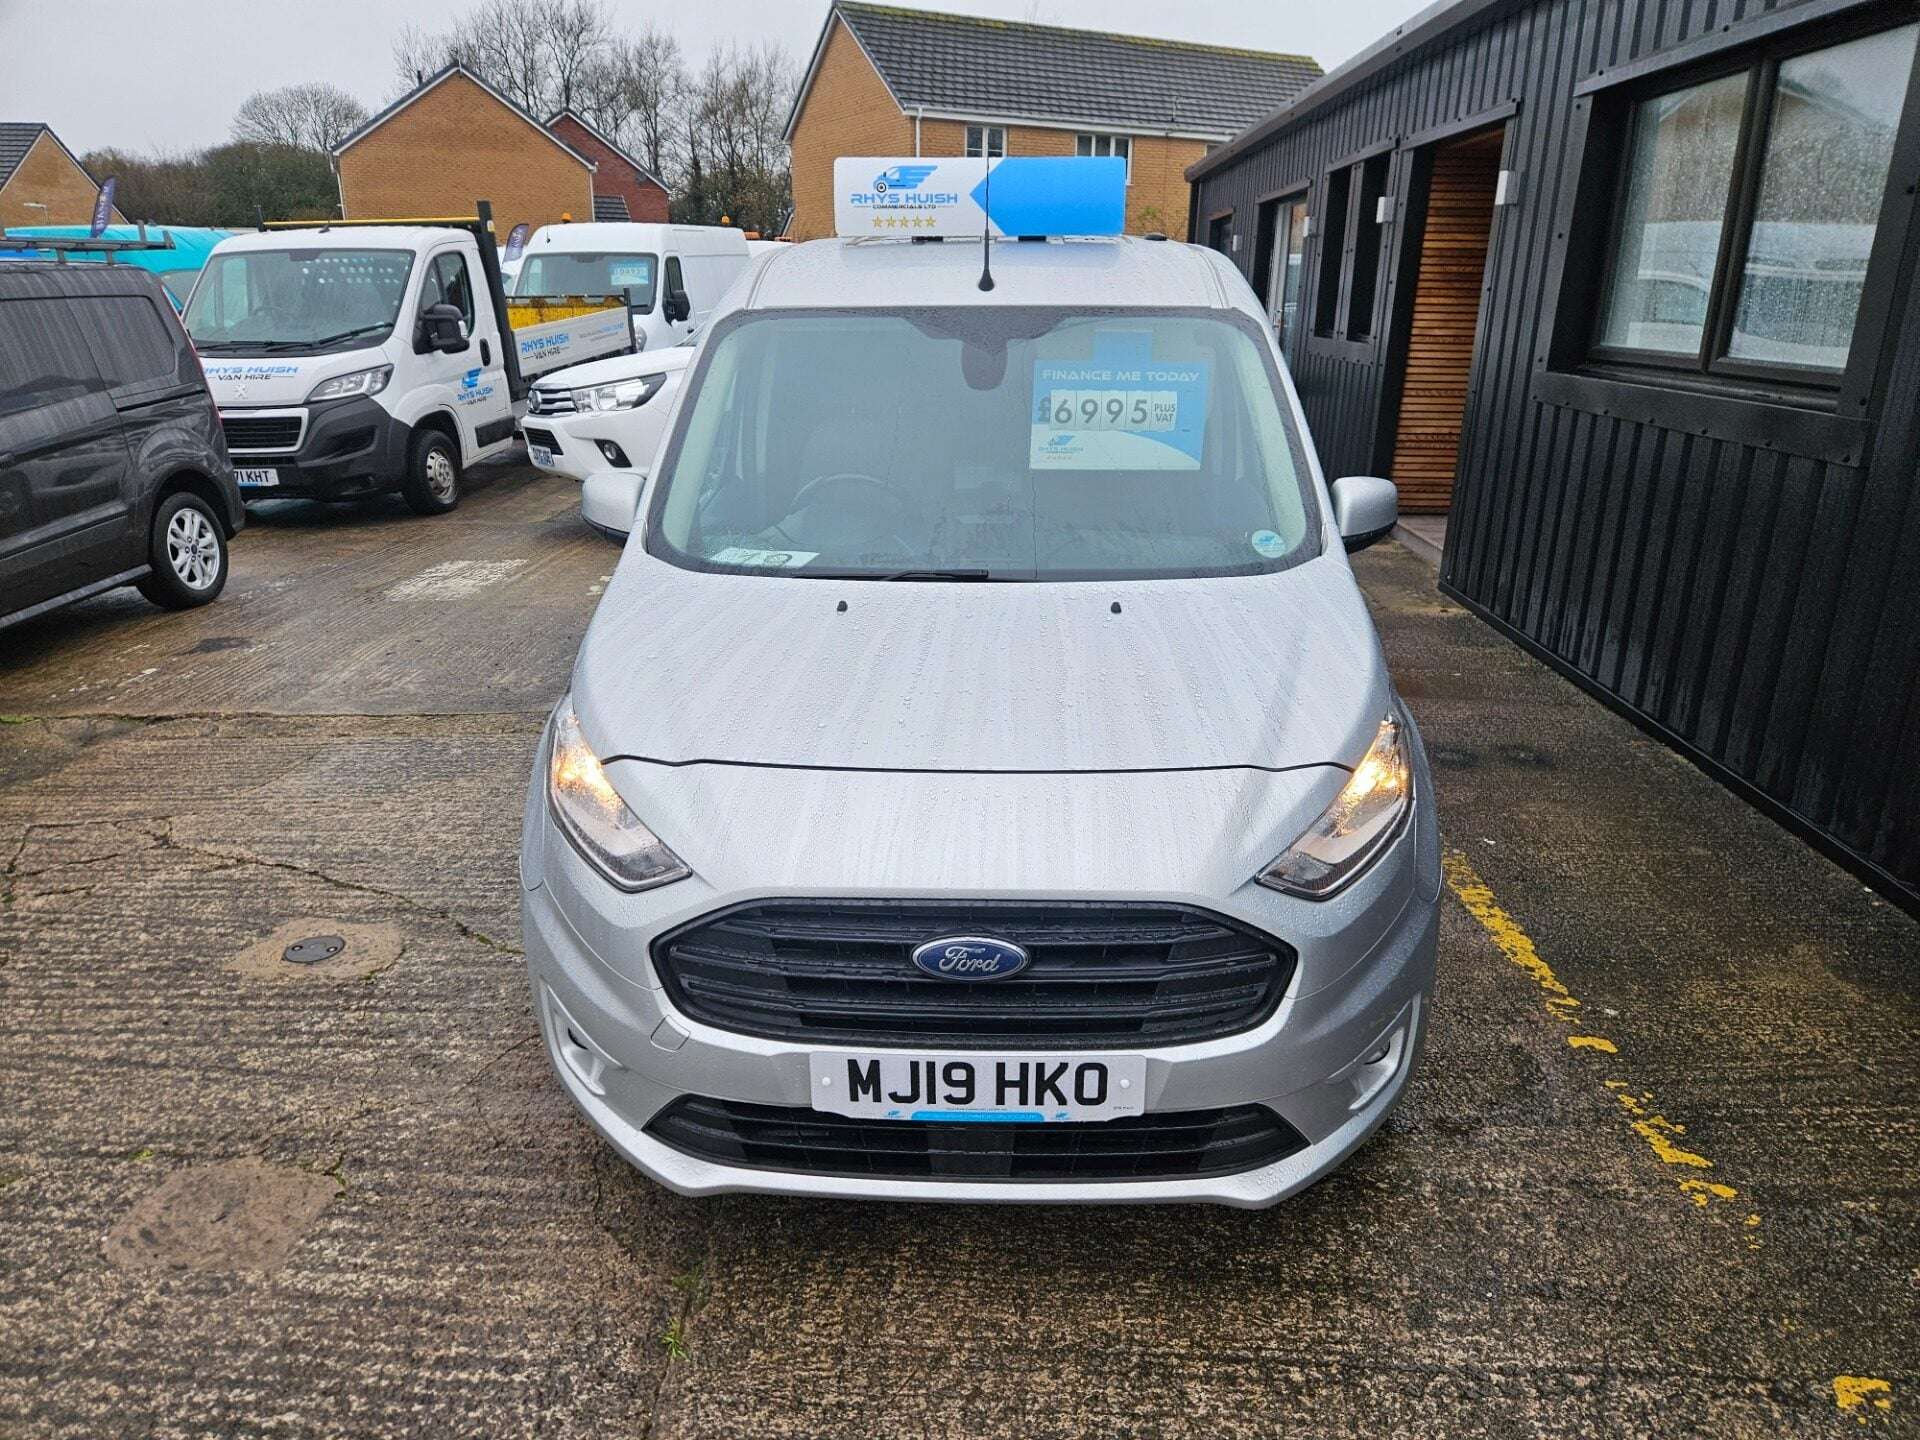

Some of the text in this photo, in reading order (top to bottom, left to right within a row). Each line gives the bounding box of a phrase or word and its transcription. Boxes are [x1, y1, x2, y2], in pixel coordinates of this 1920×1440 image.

[850, 193, 958, 204] RHYS HUISH
[521, 332, 570, 354] RHYS HUISH
[247, 366, 298, 374] HUISH
[1042, 370, 1201, 382] FINANCE ME TODAY
[1154, 402, 1176, 413] PLUS
[1154, 412, 1174, 423] VAT
[245, 470, 270, 483] KHT
[938, 945, 1001, 972] Ford
[846, 1058, 1109, 1107] MJ19 HKO
